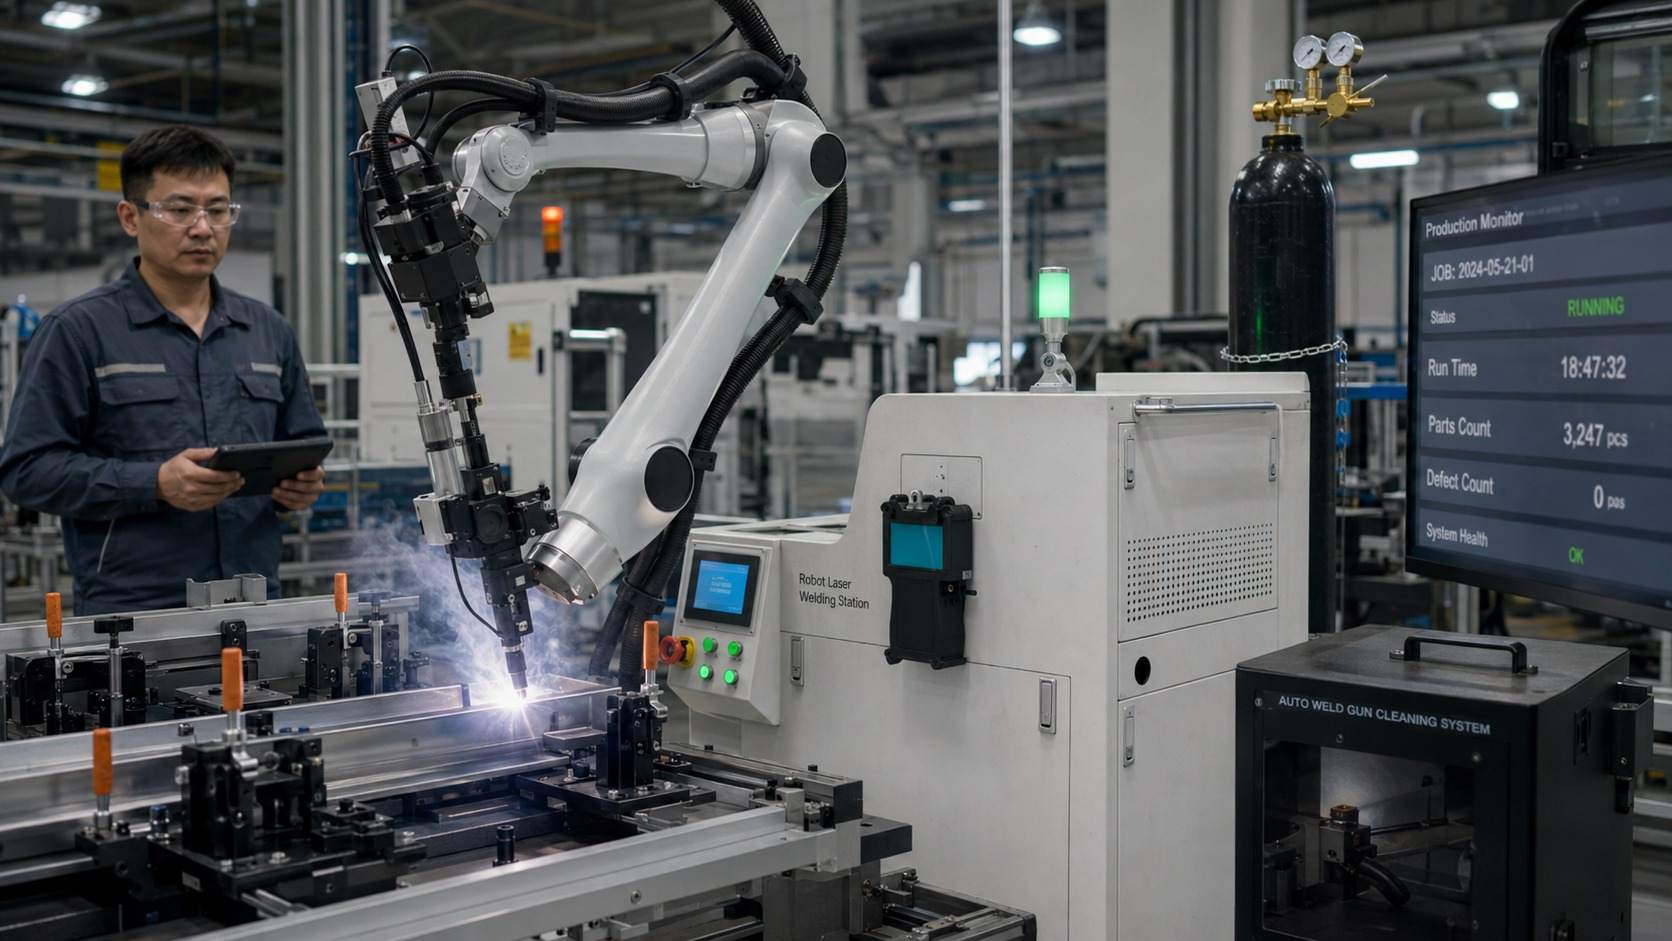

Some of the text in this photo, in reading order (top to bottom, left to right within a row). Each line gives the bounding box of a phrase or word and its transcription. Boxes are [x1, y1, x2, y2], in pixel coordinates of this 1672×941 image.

[1426, 211, 1524, 238] Production Monitor
[1431, 255, 1534, 282] JOB: 2024-05-21-01
[1431, 310, 1456, 324] Status
[1567, 296, 1625, 317] RUNNING
[1428, 358, 1477, 377] Run Time
[1561, 355, 1626, 379] 18:47:32
[1428, 415, 1491, 438] Parts Count
[1563, 422, 1628, 449] 3,247 pcs
[1426, 469, 1494, 495] Defect Count
[1594, 485, 1604, 509] 0
[1426, 522, 1488, 548] System Health
[1568, 545, 1584, 565] OK
[799, 573, 851, 590] Robot Laser
[799, 591, 870, 609] Welding Station
[1279, 695, 1491, 735] AUTO WELD GUN CLEANING SYSTEM
